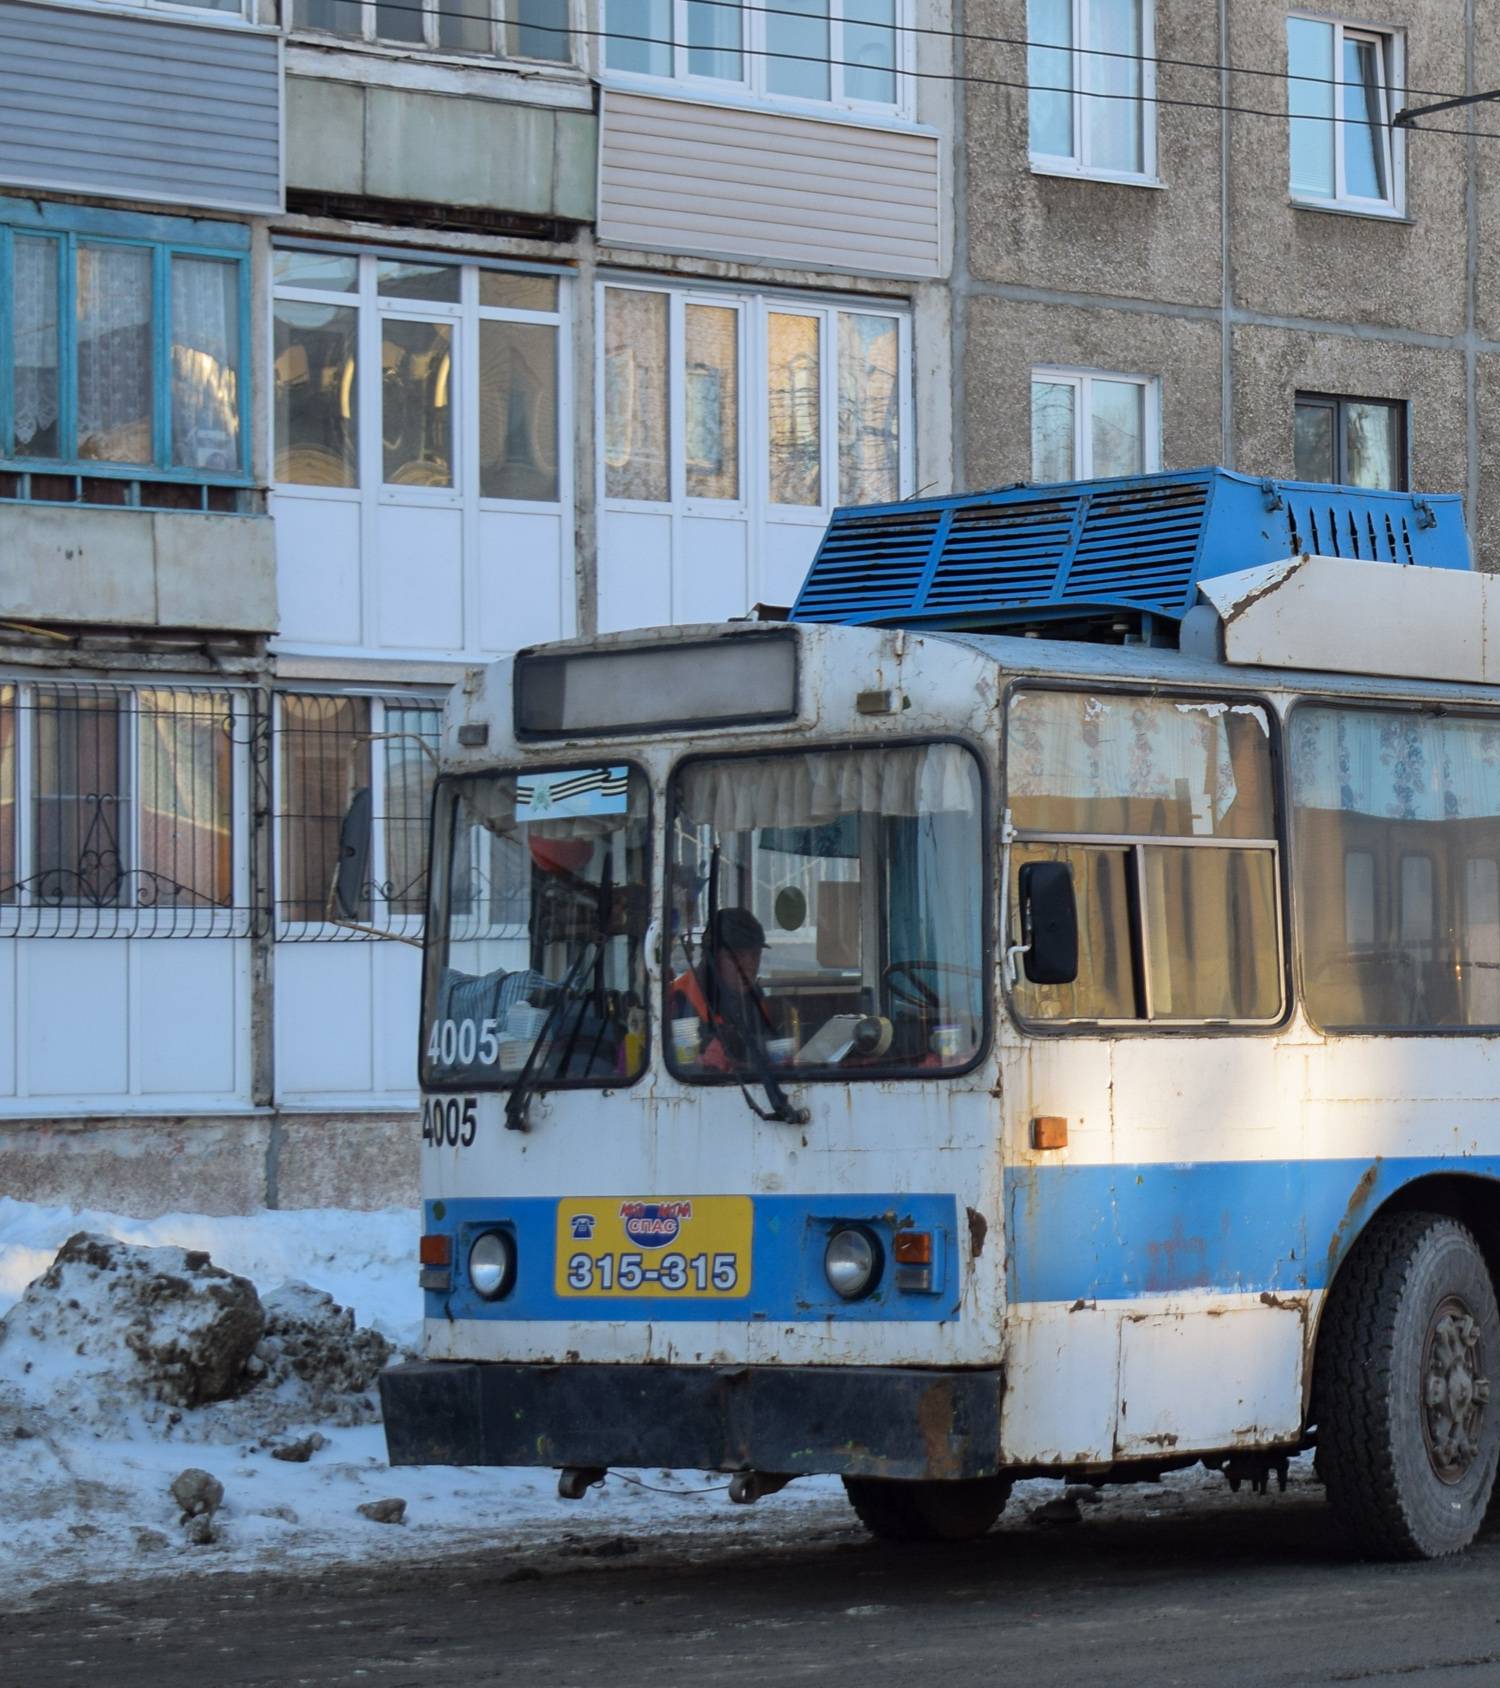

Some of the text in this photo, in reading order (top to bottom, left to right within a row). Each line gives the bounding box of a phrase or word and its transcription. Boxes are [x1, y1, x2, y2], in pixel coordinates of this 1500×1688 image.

[426, 1018, 499, 1066] 4005
[422, 1098, 477, 1148] 4005
[628, 1218, 677, 1234] СПАС
[568, 1253, 737, 1290] 315-315
